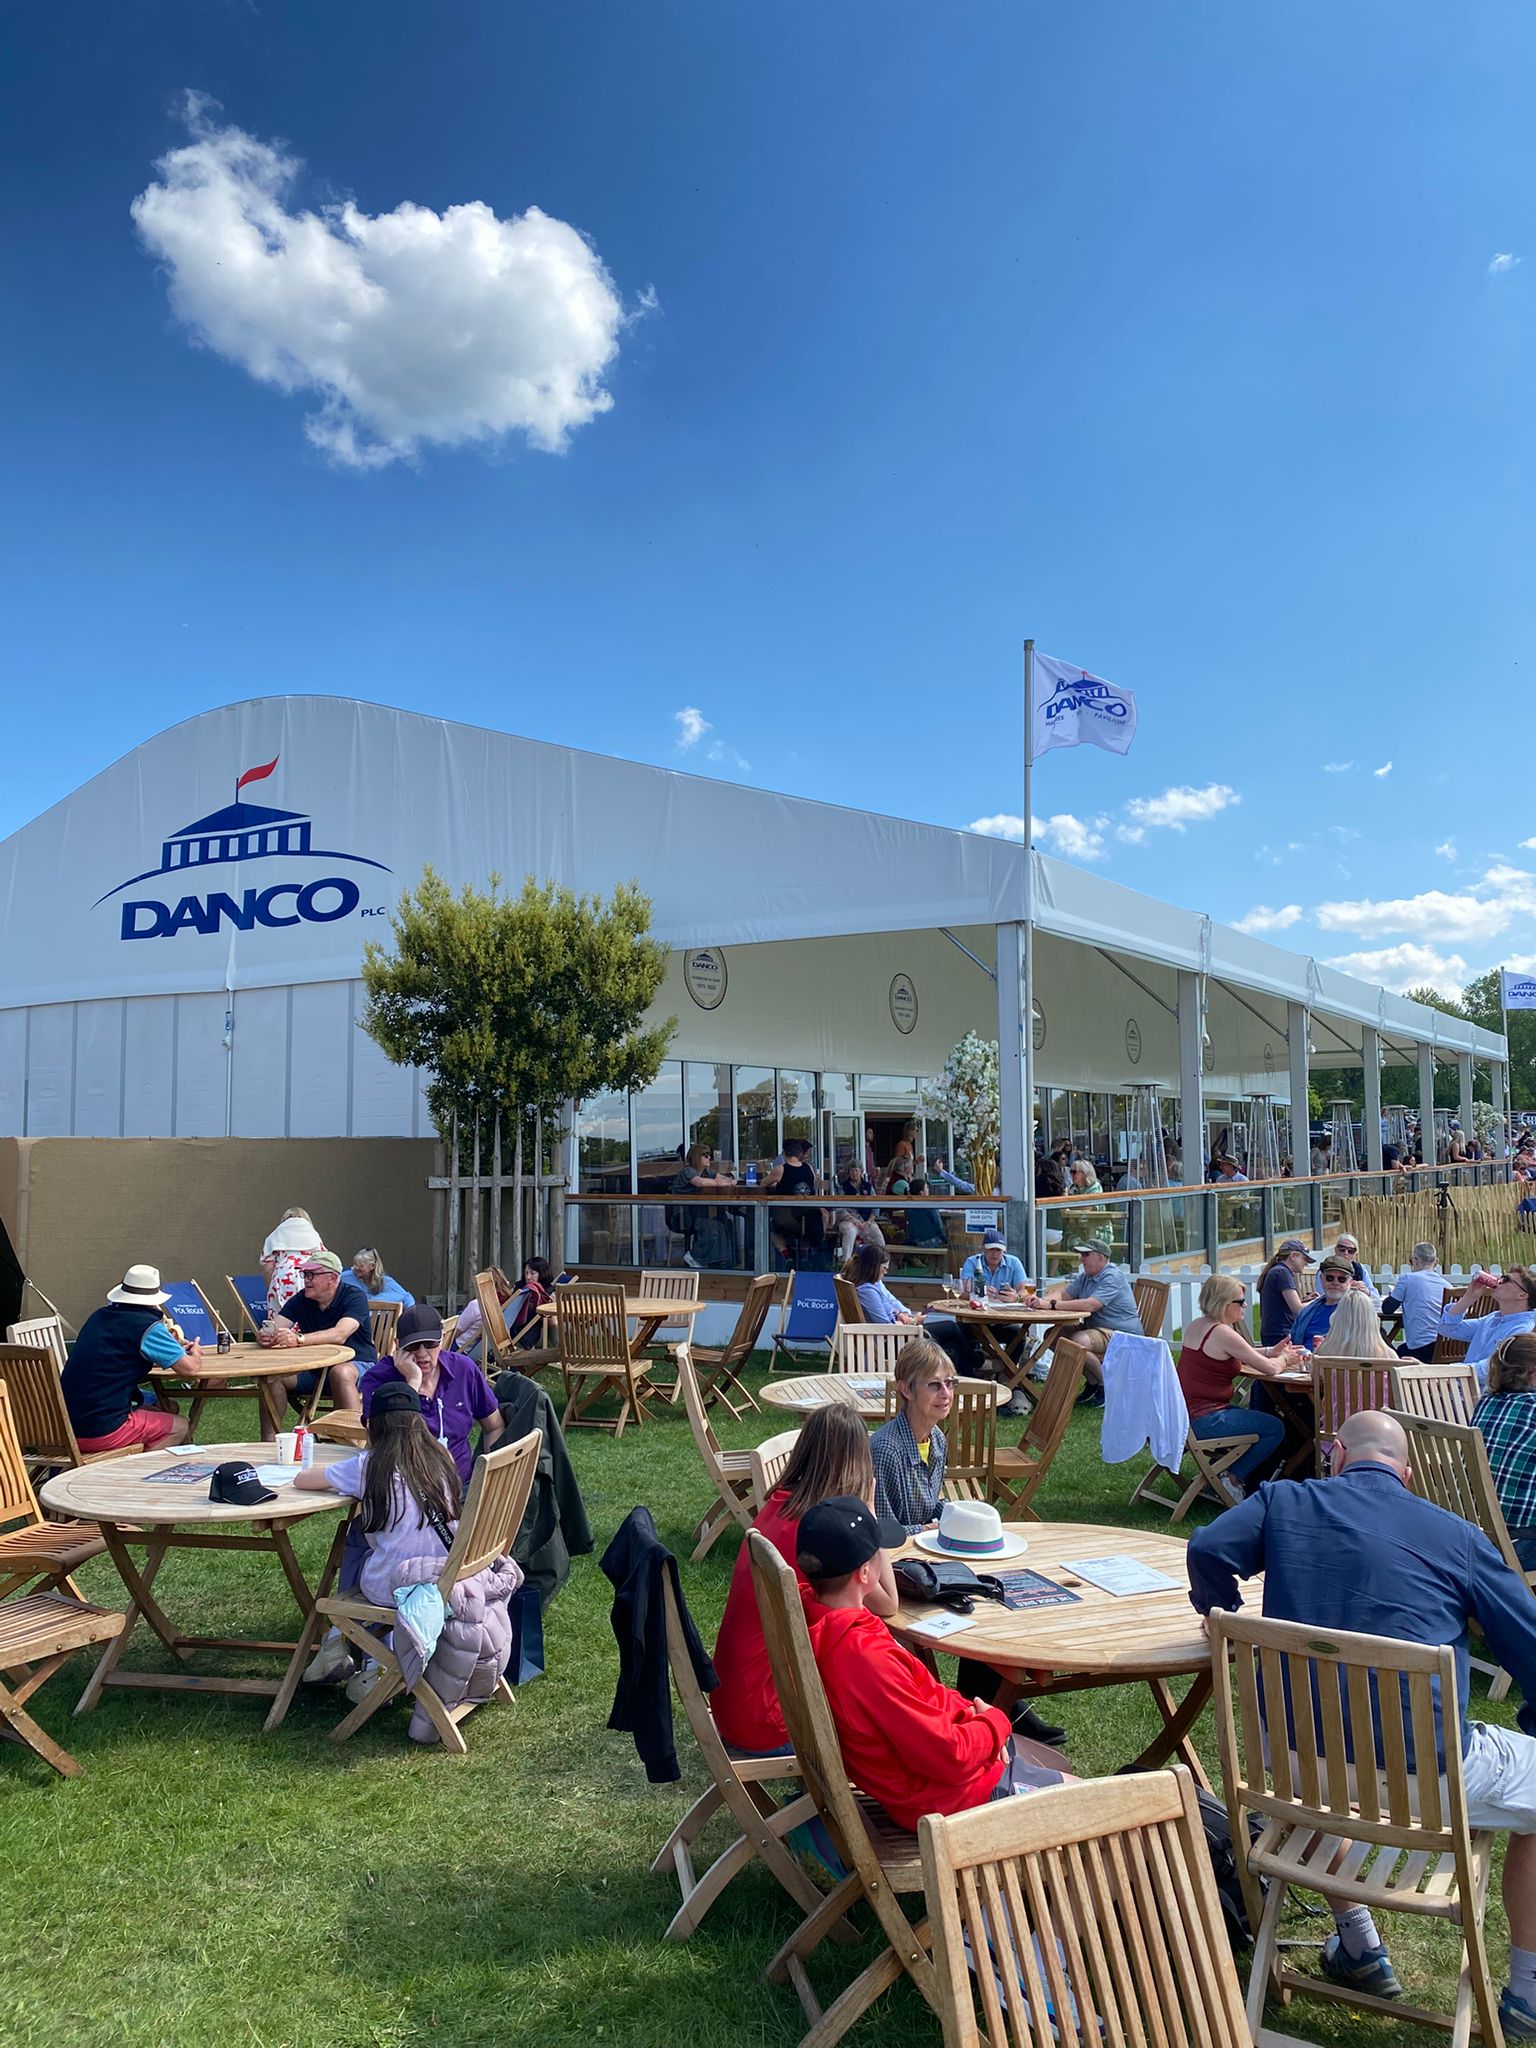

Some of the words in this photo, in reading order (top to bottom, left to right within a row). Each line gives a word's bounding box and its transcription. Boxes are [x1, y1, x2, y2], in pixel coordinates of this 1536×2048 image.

[1046, 695, 1127, 719] DANCO
[120, 877, 360, 940] DANCO
[361, 906, 386, 917] PLC
[692, 961, 719, 970] DANCO
[797, 1300, 810, 1309] POL
[811, 1302, 834, 1310] ROGER
